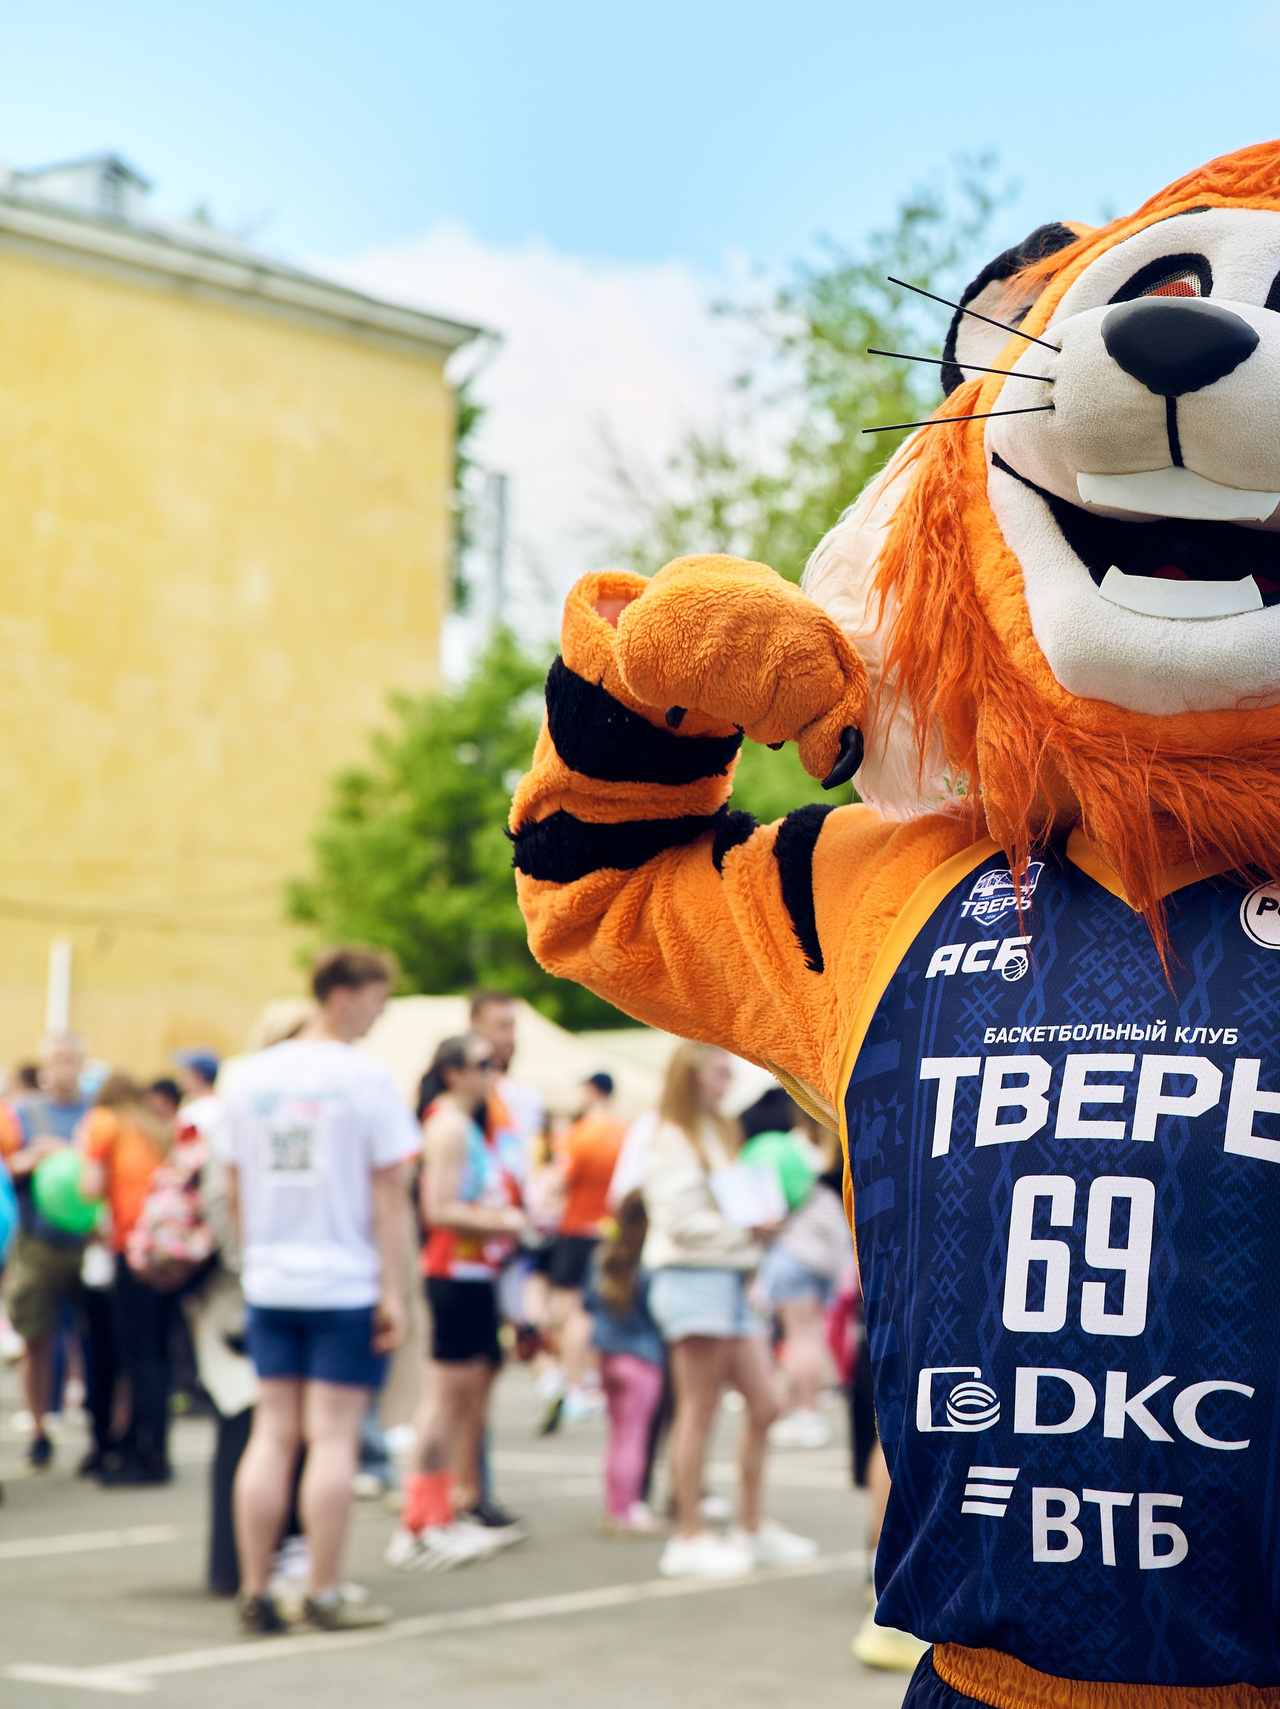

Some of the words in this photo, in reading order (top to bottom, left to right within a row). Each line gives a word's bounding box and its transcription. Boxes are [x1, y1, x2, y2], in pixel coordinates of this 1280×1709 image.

[961, 896, 1032, 918] ТВЕРЬ
[925, 935, 1033, 982] АСБ
[983, 1019, 1167, 1044] БАСКЕТБОЛЬНЫЙ
[1174, 1026, 1239, 1045] КЛУБ
[1002, 1174, 1156, 1337] 69
[1013, 1366, 1256, 1451] DKC
[1031, 1486, 1189, 1570] ВТБ
